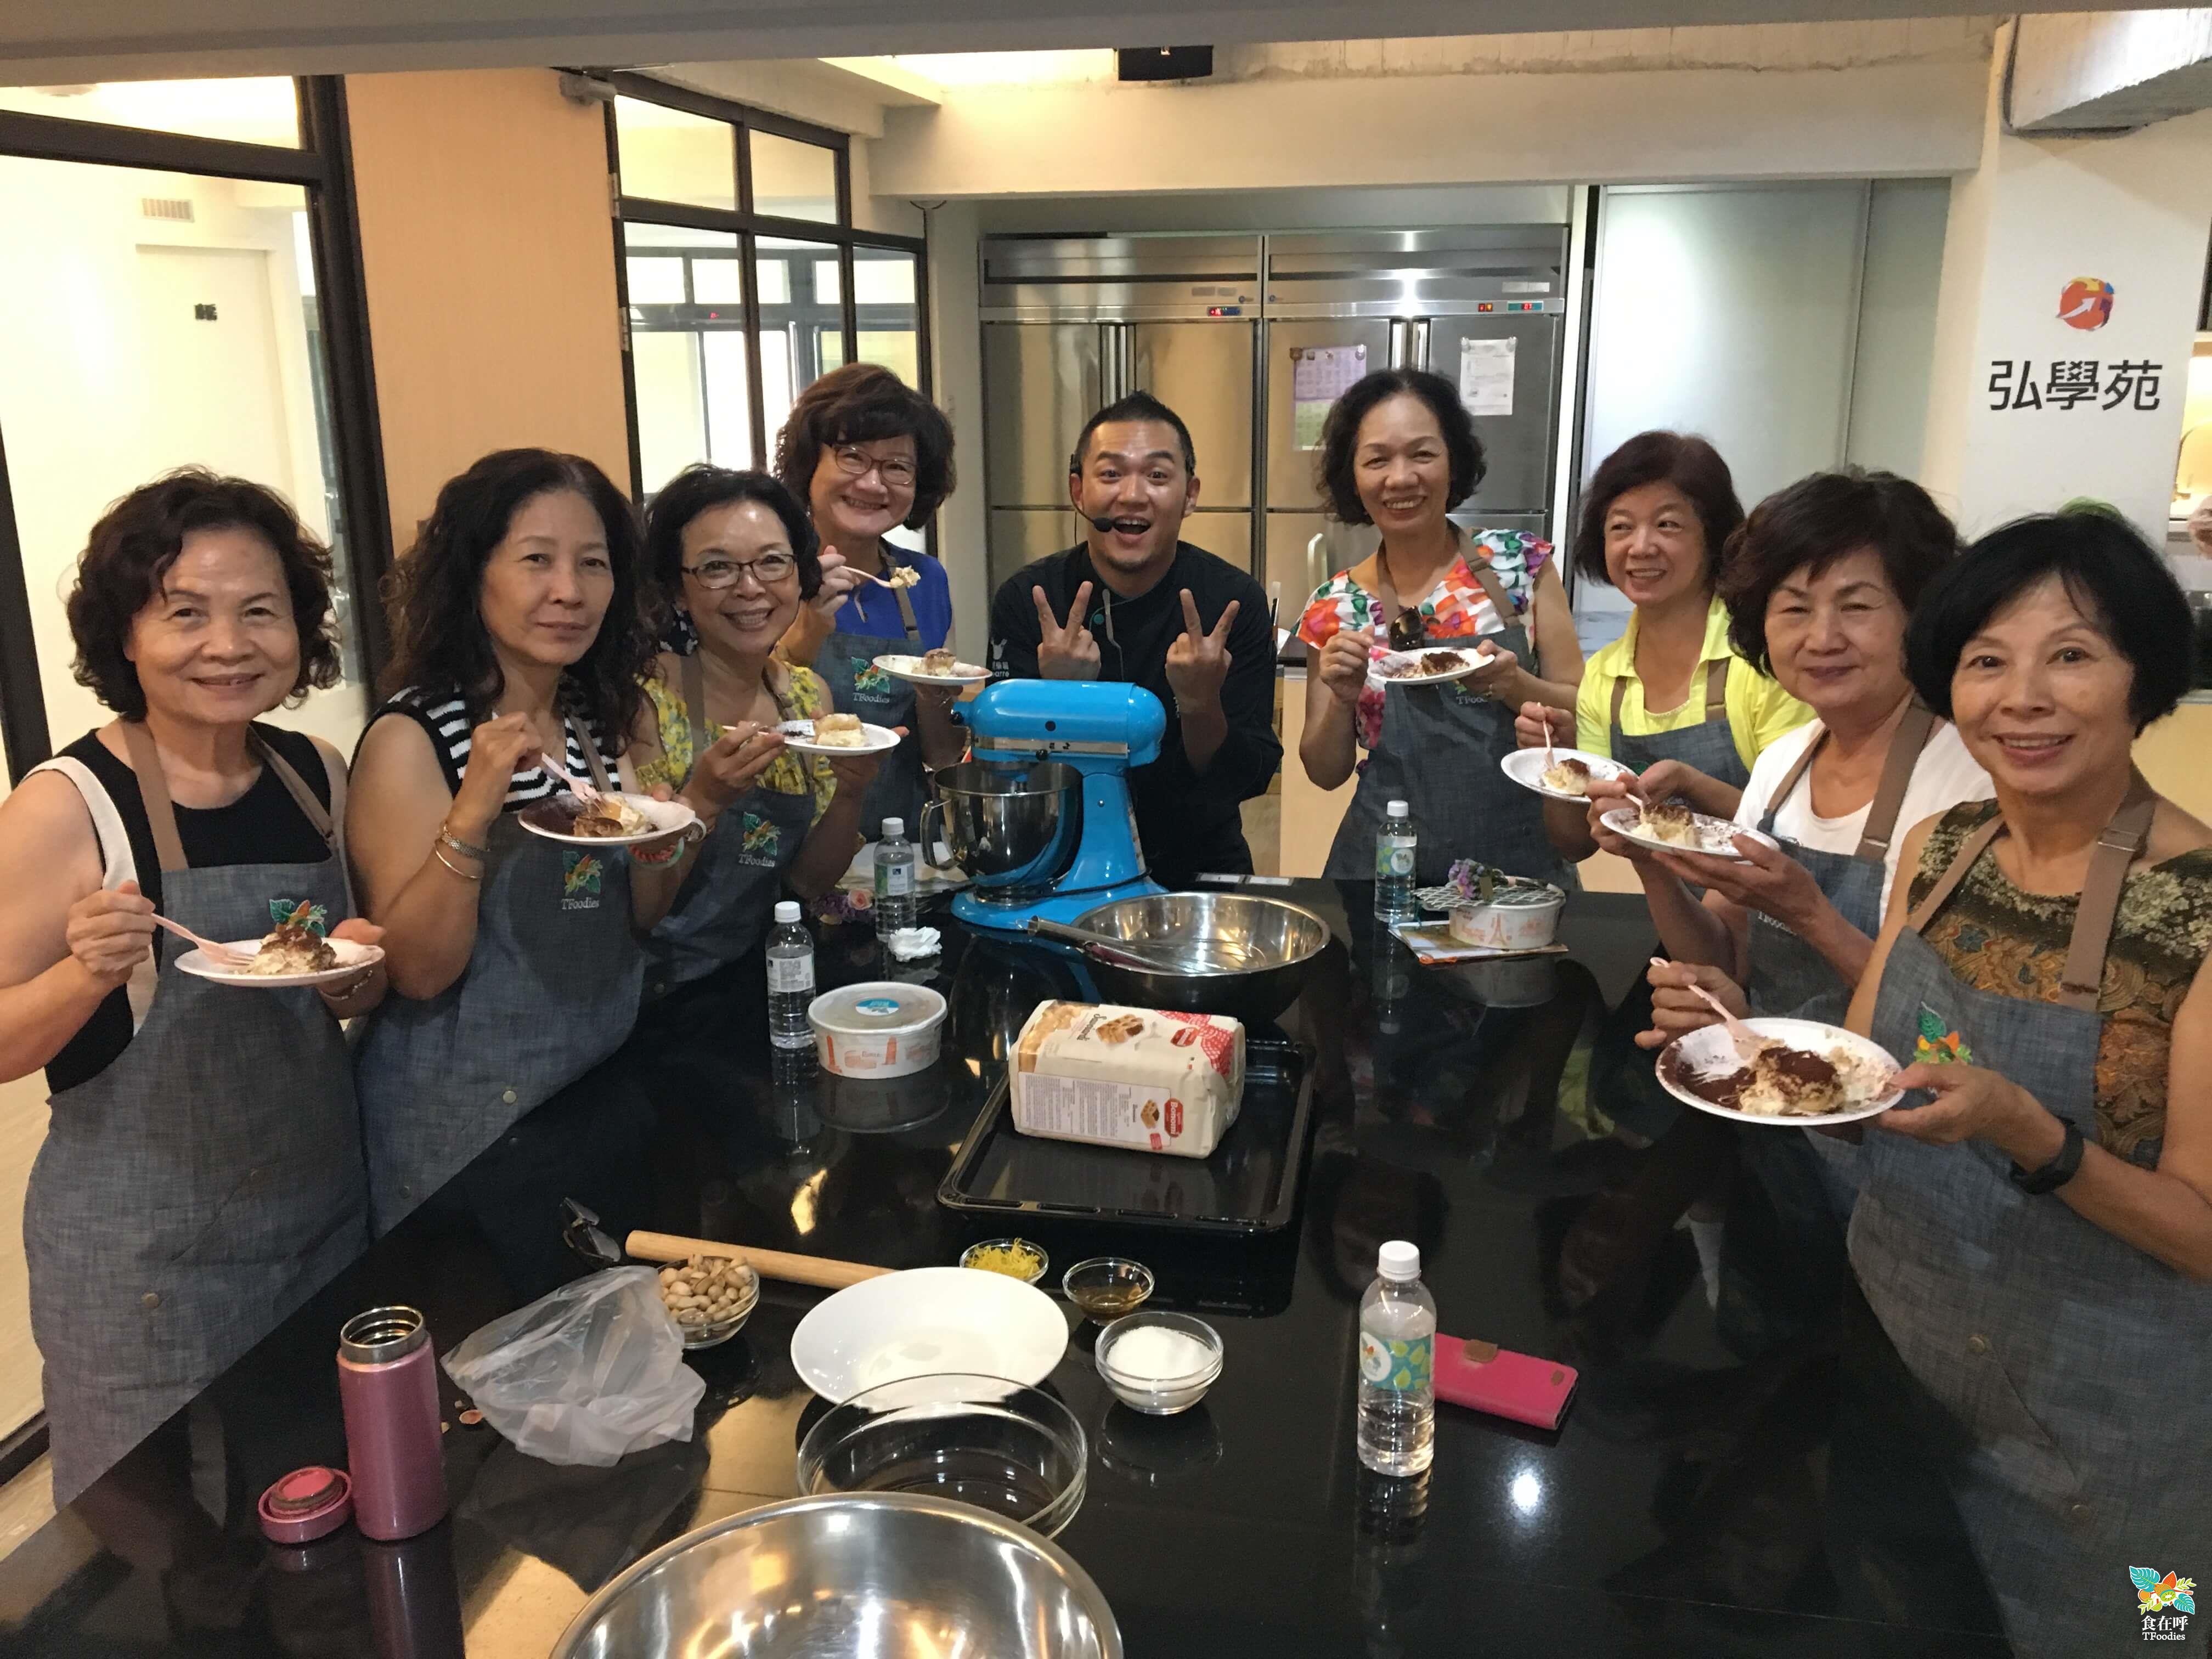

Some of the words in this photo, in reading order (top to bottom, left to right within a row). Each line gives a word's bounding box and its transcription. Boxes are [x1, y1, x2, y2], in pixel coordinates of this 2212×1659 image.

[1989, 360, 2163, 410] 弘學苑
[561, 896, 600, 910] TFoodies
[1170, 1101, 1179, 1135] Bonomi
